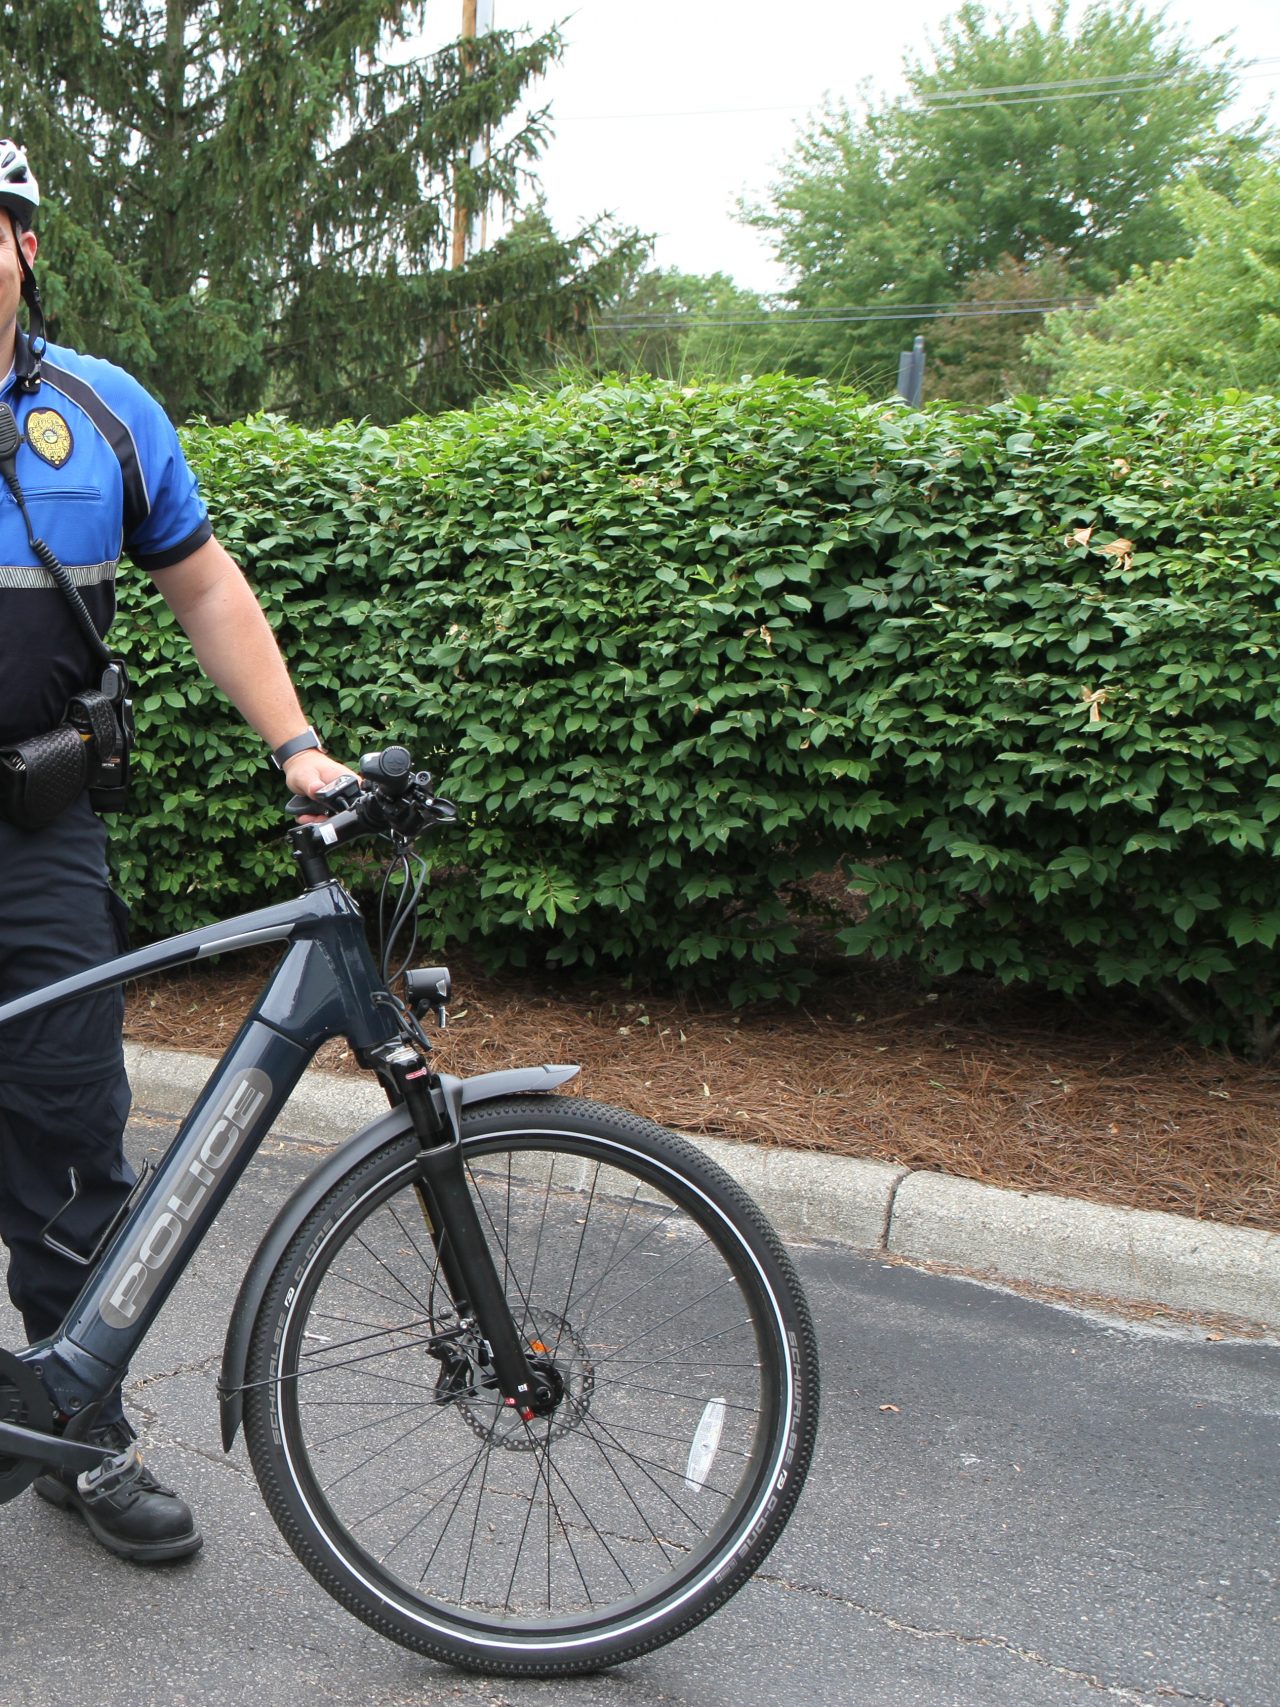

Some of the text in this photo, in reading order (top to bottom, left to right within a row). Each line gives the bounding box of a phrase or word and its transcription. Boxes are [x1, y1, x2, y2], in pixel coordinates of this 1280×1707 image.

[109, 1080, 265, 1318] POLICE
[269, 1312, 287, 1446] SCHWALBE
[784, 1331, 803, 1465] SCHWALBE
